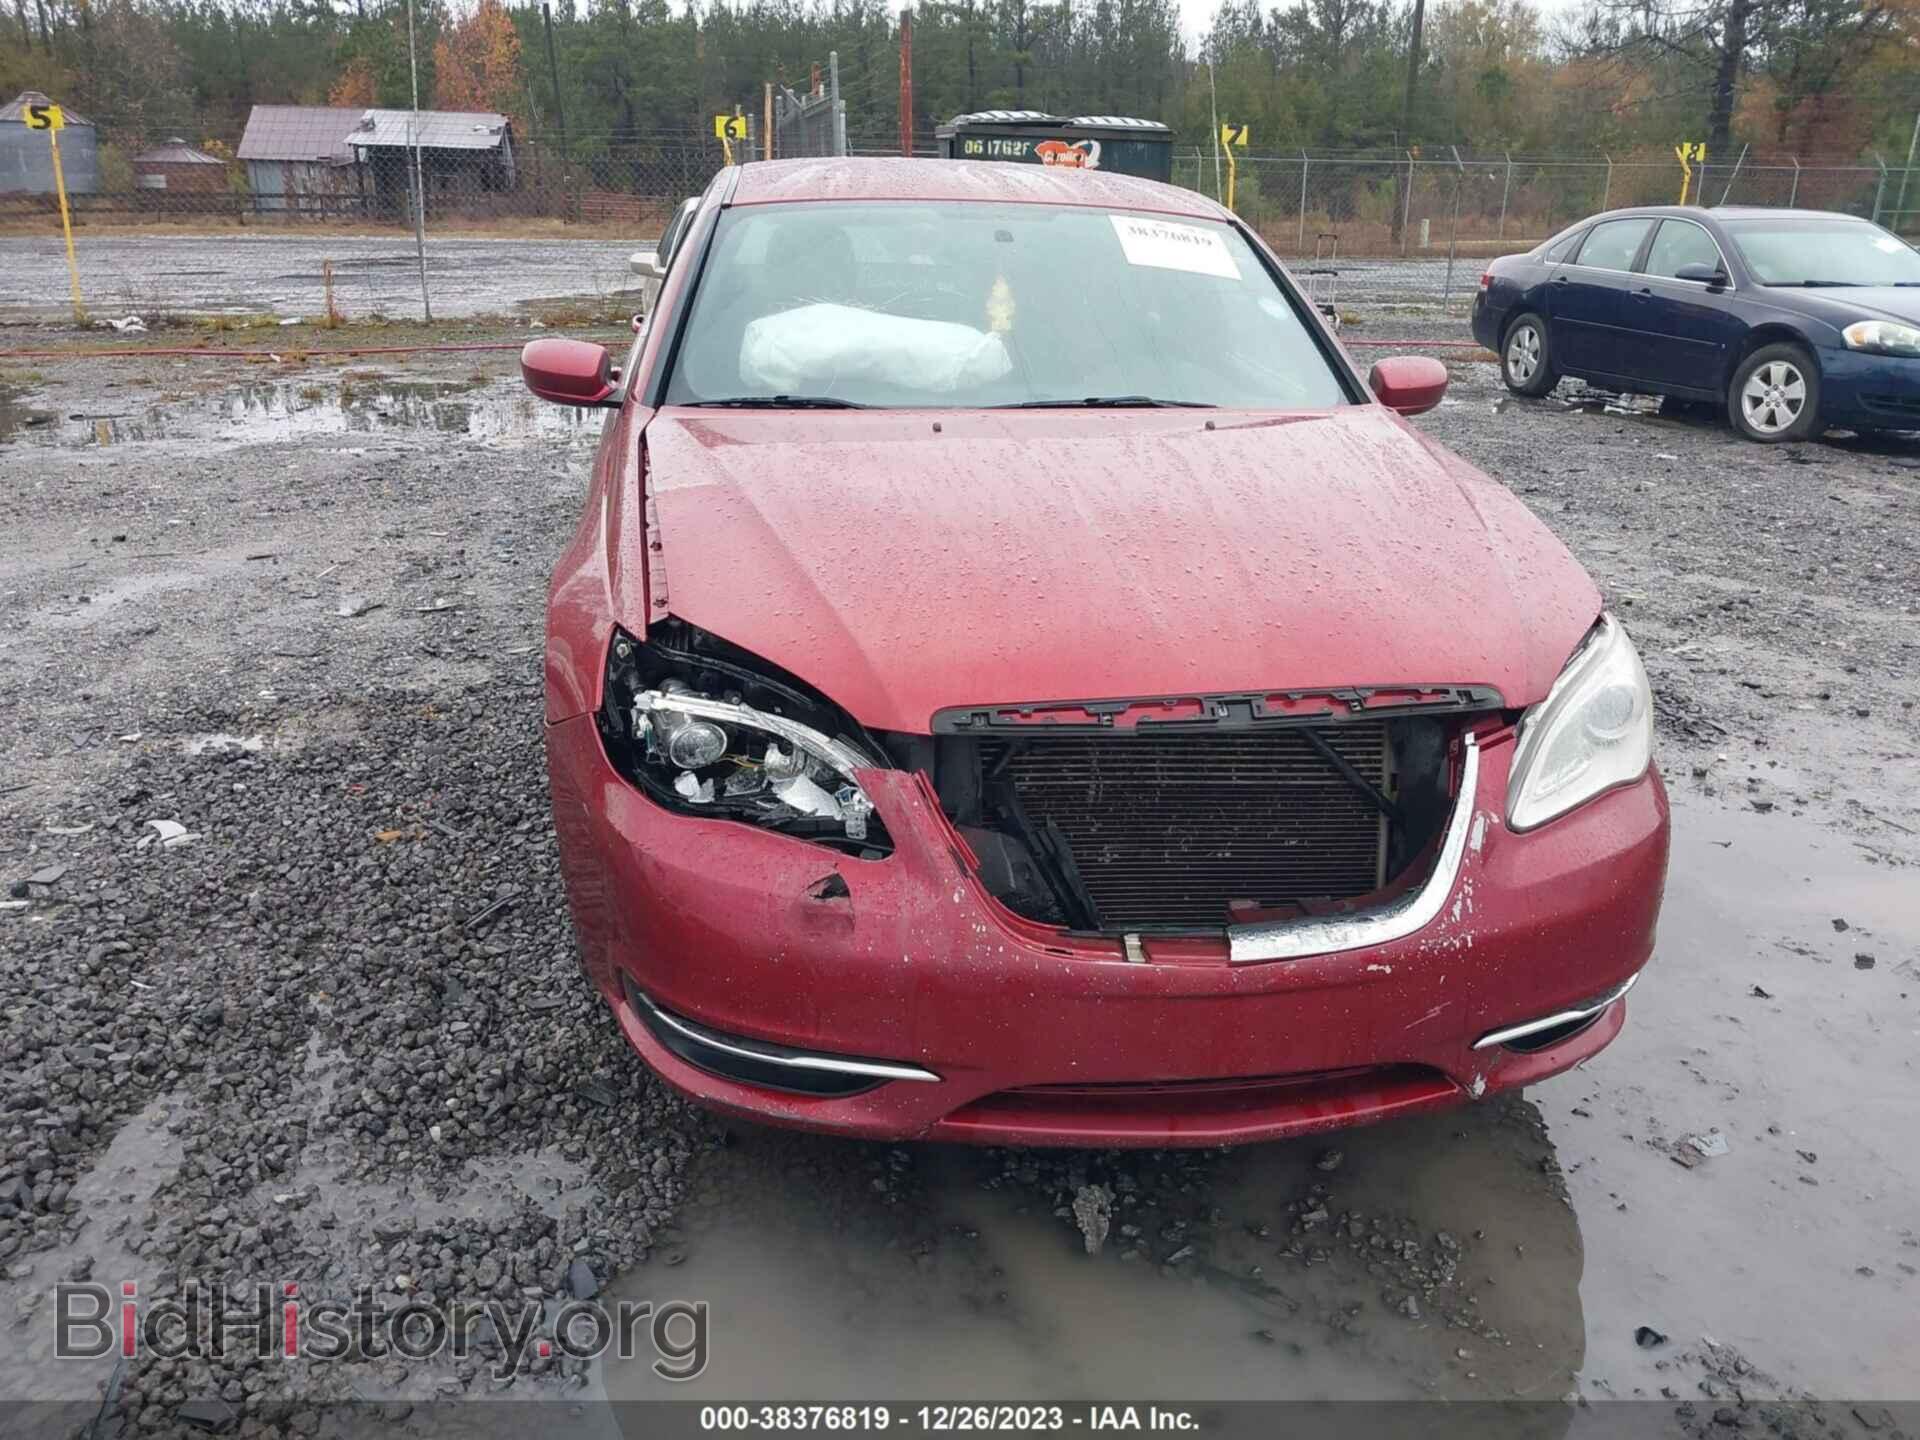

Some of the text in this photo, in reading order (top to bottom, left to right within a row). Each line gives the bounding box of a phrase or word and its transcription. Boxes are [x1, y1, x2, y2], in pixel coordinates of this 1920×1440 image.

[30, 105, 52, 129] 5
[724, 116, 739, 140] 6
[1227, 122, 1244, 145] 7
[1687, 142, 1700, 161] 8
